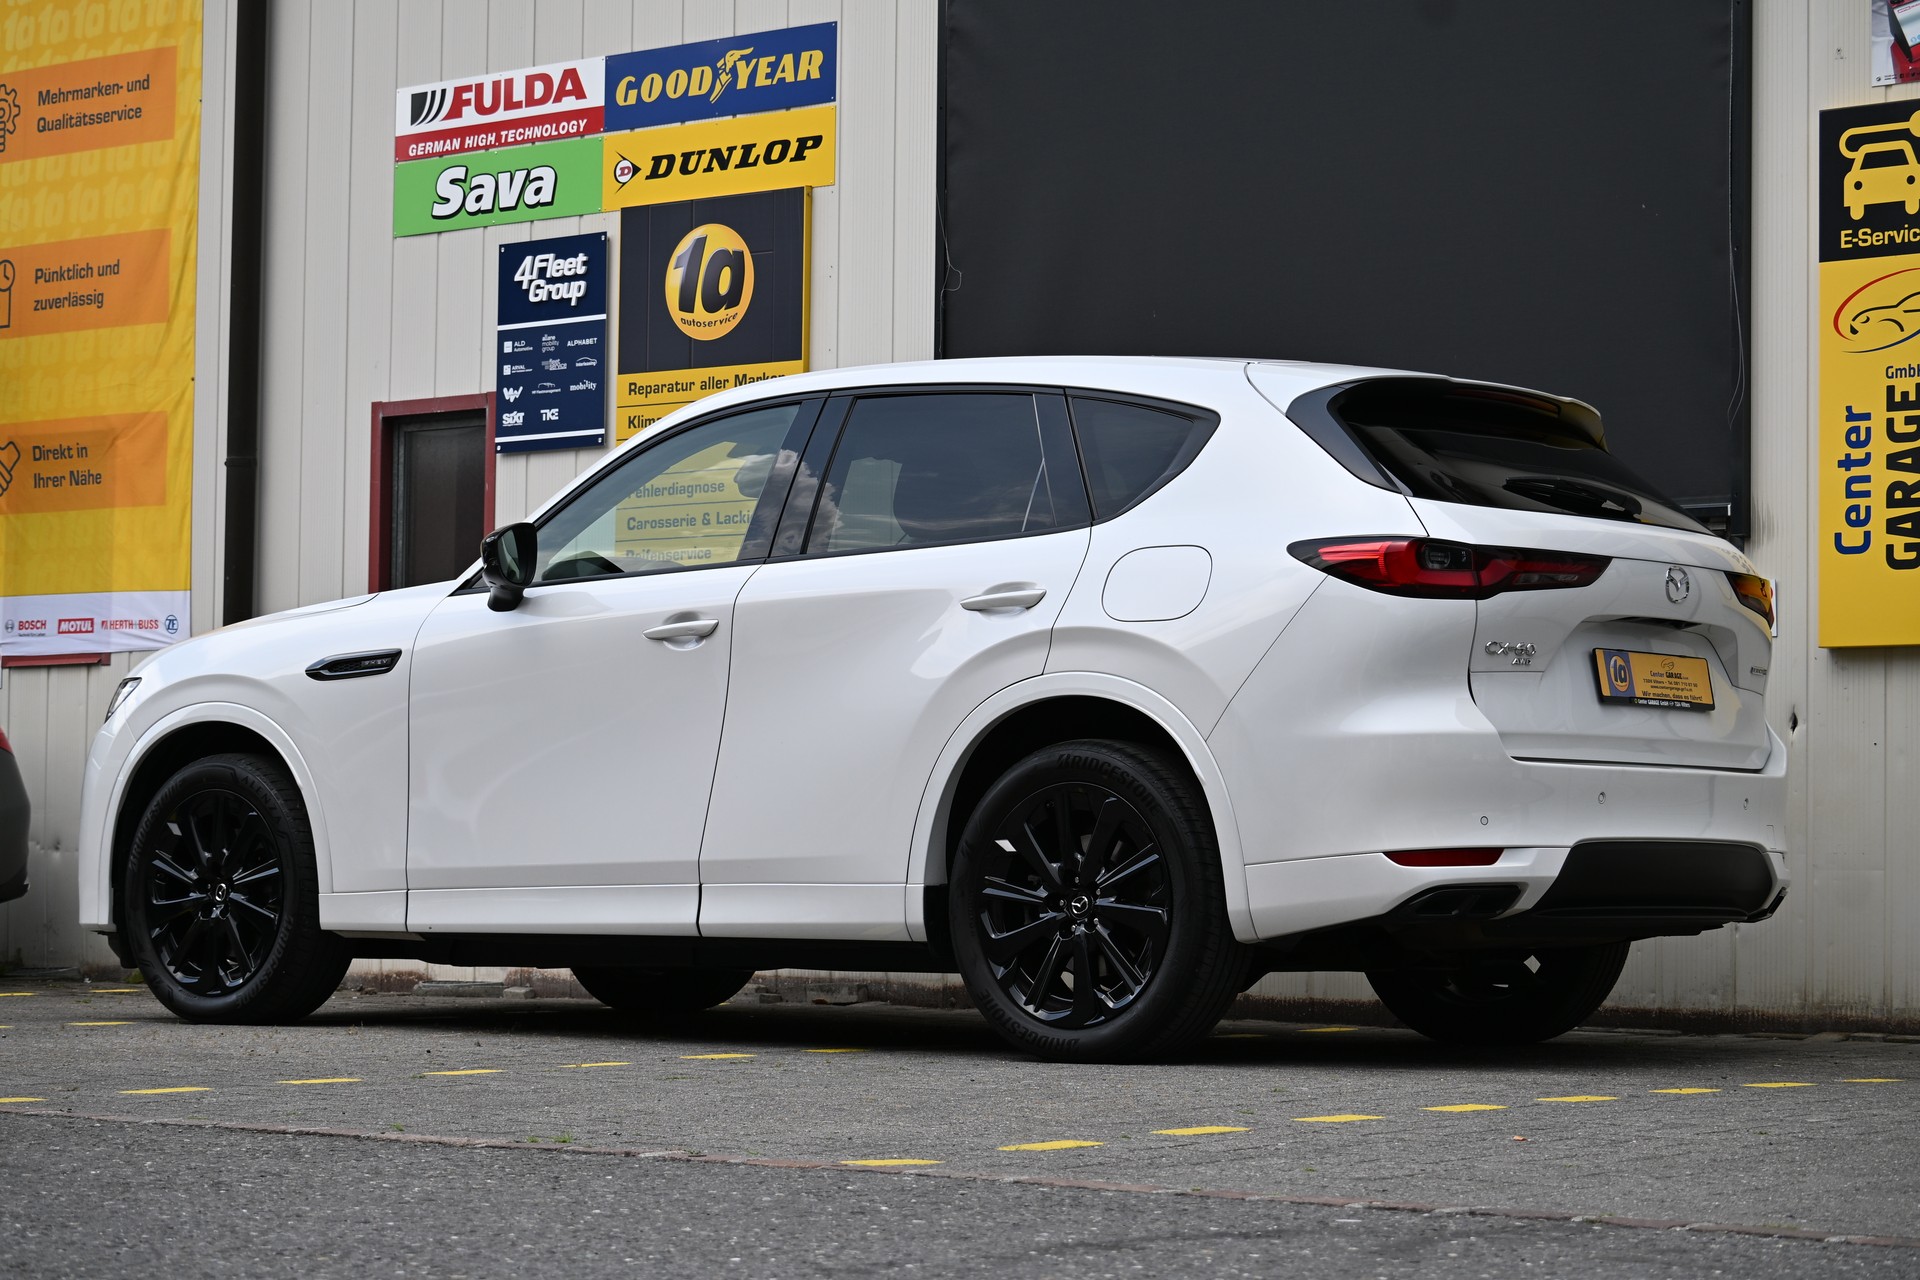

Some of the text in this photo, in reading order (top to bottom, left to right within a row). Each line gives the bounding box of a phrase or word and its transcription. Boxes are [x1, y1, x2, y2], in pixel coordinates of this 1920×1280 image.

[38, 74, 150, 106] Mehrmarken- und
[441, 67, 587, 122] FULDA
[37, 105, 142, 133] Qualitätsservice
[408, 138, 461, 157] GERMAN
[500, 118, 587, 144] TECHNOLOGY
[645, 134, 823, 181] DUNLOP
[431, 165, 557, 219] Sava
[35, 259, 120, 284] Pünktlich und
[514, 253, 588, 289] 4Fleet
[673, 234, 745, 314] 1a
[34, 290, 104, 311] zuverlässig
[528, 280, 587, 306] Group
[680, 312, 738, 328] autoservice
[567, 338, 597, 347] ALPHABET
[628, 372, 786, 399] Reparatur aller Mark
[628, 415, 660, 429] Klim
[32, 443, 88, 462] Direkt in
[33, 470, 102, 489] Ihrer Nähe
[1834, 405, 1872, 555] Center
[1885, 382, 1920, 570] GARAGE
[629, 482, 725, 498] ehlerdiagnose
[627, 513, 696, 531] Carosserie
[702, 512, 711, 525] &
[18, 620, 47, 631] BOSCH
[59, 620, 93, 632] MOTUL
